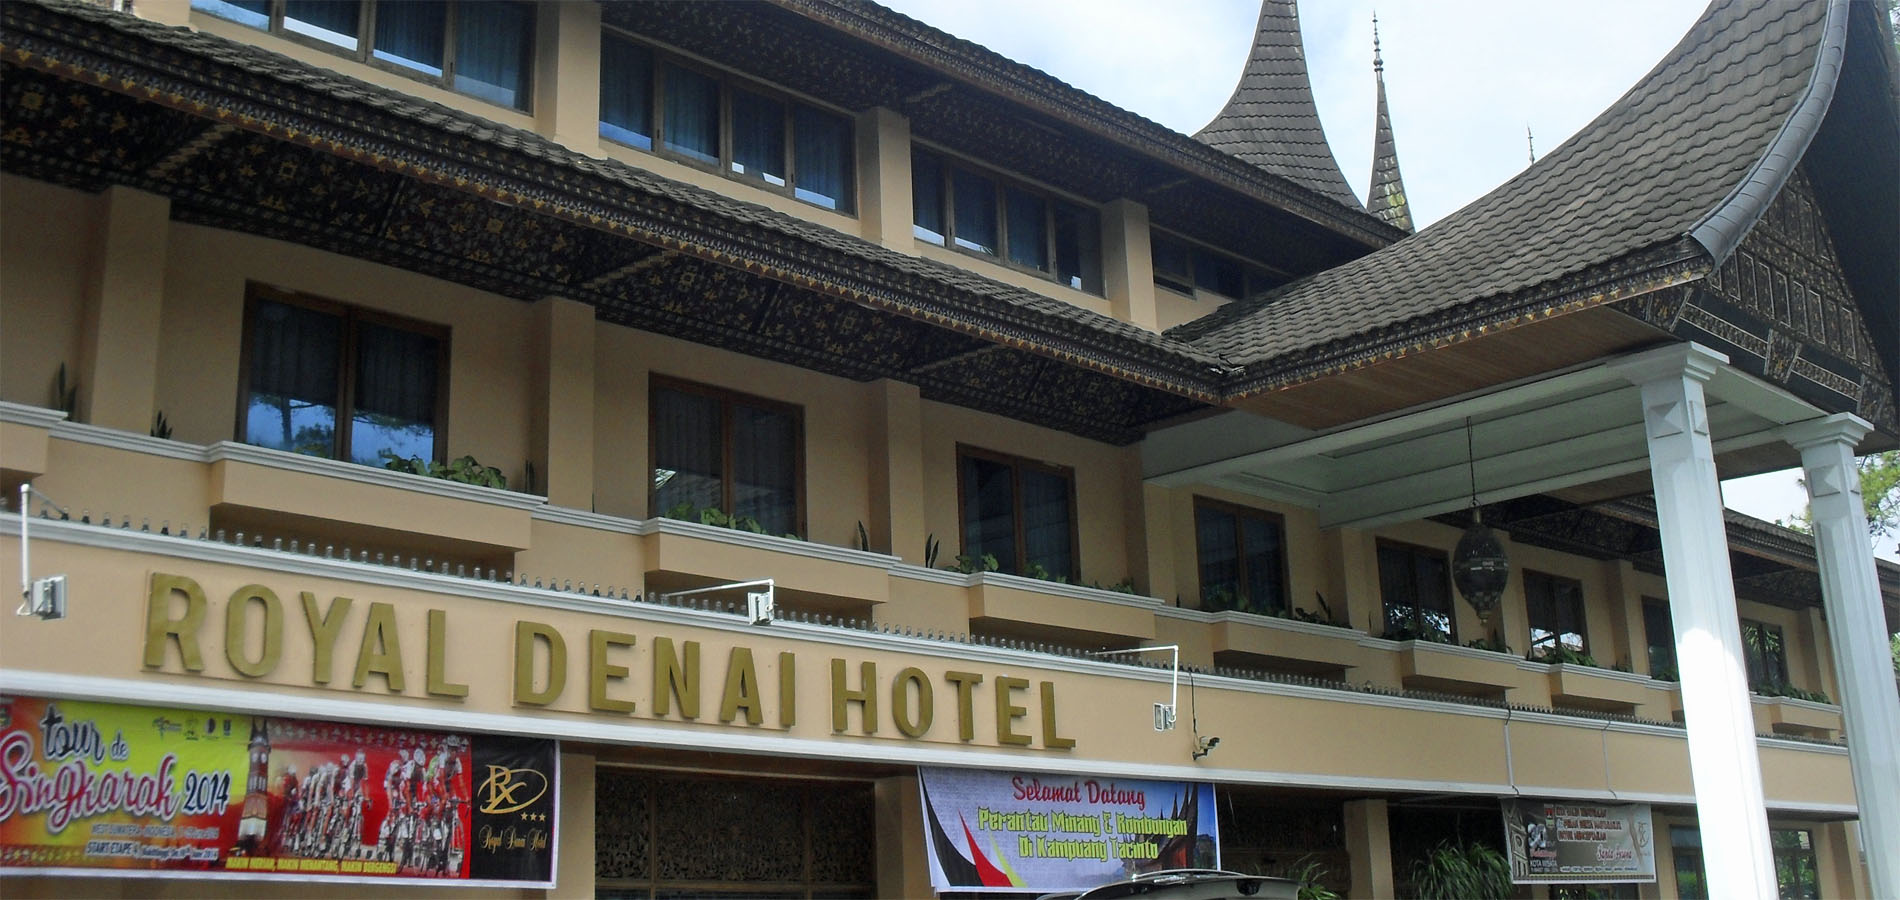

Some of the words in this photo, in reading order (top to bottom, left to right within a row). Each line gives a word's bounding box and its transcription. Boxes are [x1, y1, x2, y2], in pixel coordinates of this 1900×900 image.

[144, 572, 469, 697] ROYAL
[513, 620, 796, 727] DENAI
[831, 658, 1076, 749] HOTEL
[40, 703, 105, 764] tour
[110, 729, 129, 760] de
[0, 730, 180, 834] Singkarak
[182, 769, 231, 816] 2014
[1012, 775, 1082, 803] Selamat
[1085, 780, 1145, 810] Datang
[978, 806, 1049, 832] Perantau
[1051, 810, 1101, 837] Minang
[1116, 811, 1188, 837] Rombongan
[1018, 834, 1034, 858] Di
[1036, 835, 1108, 862] Kampuang
[1109, 836, 1159, 860] Tacinto
